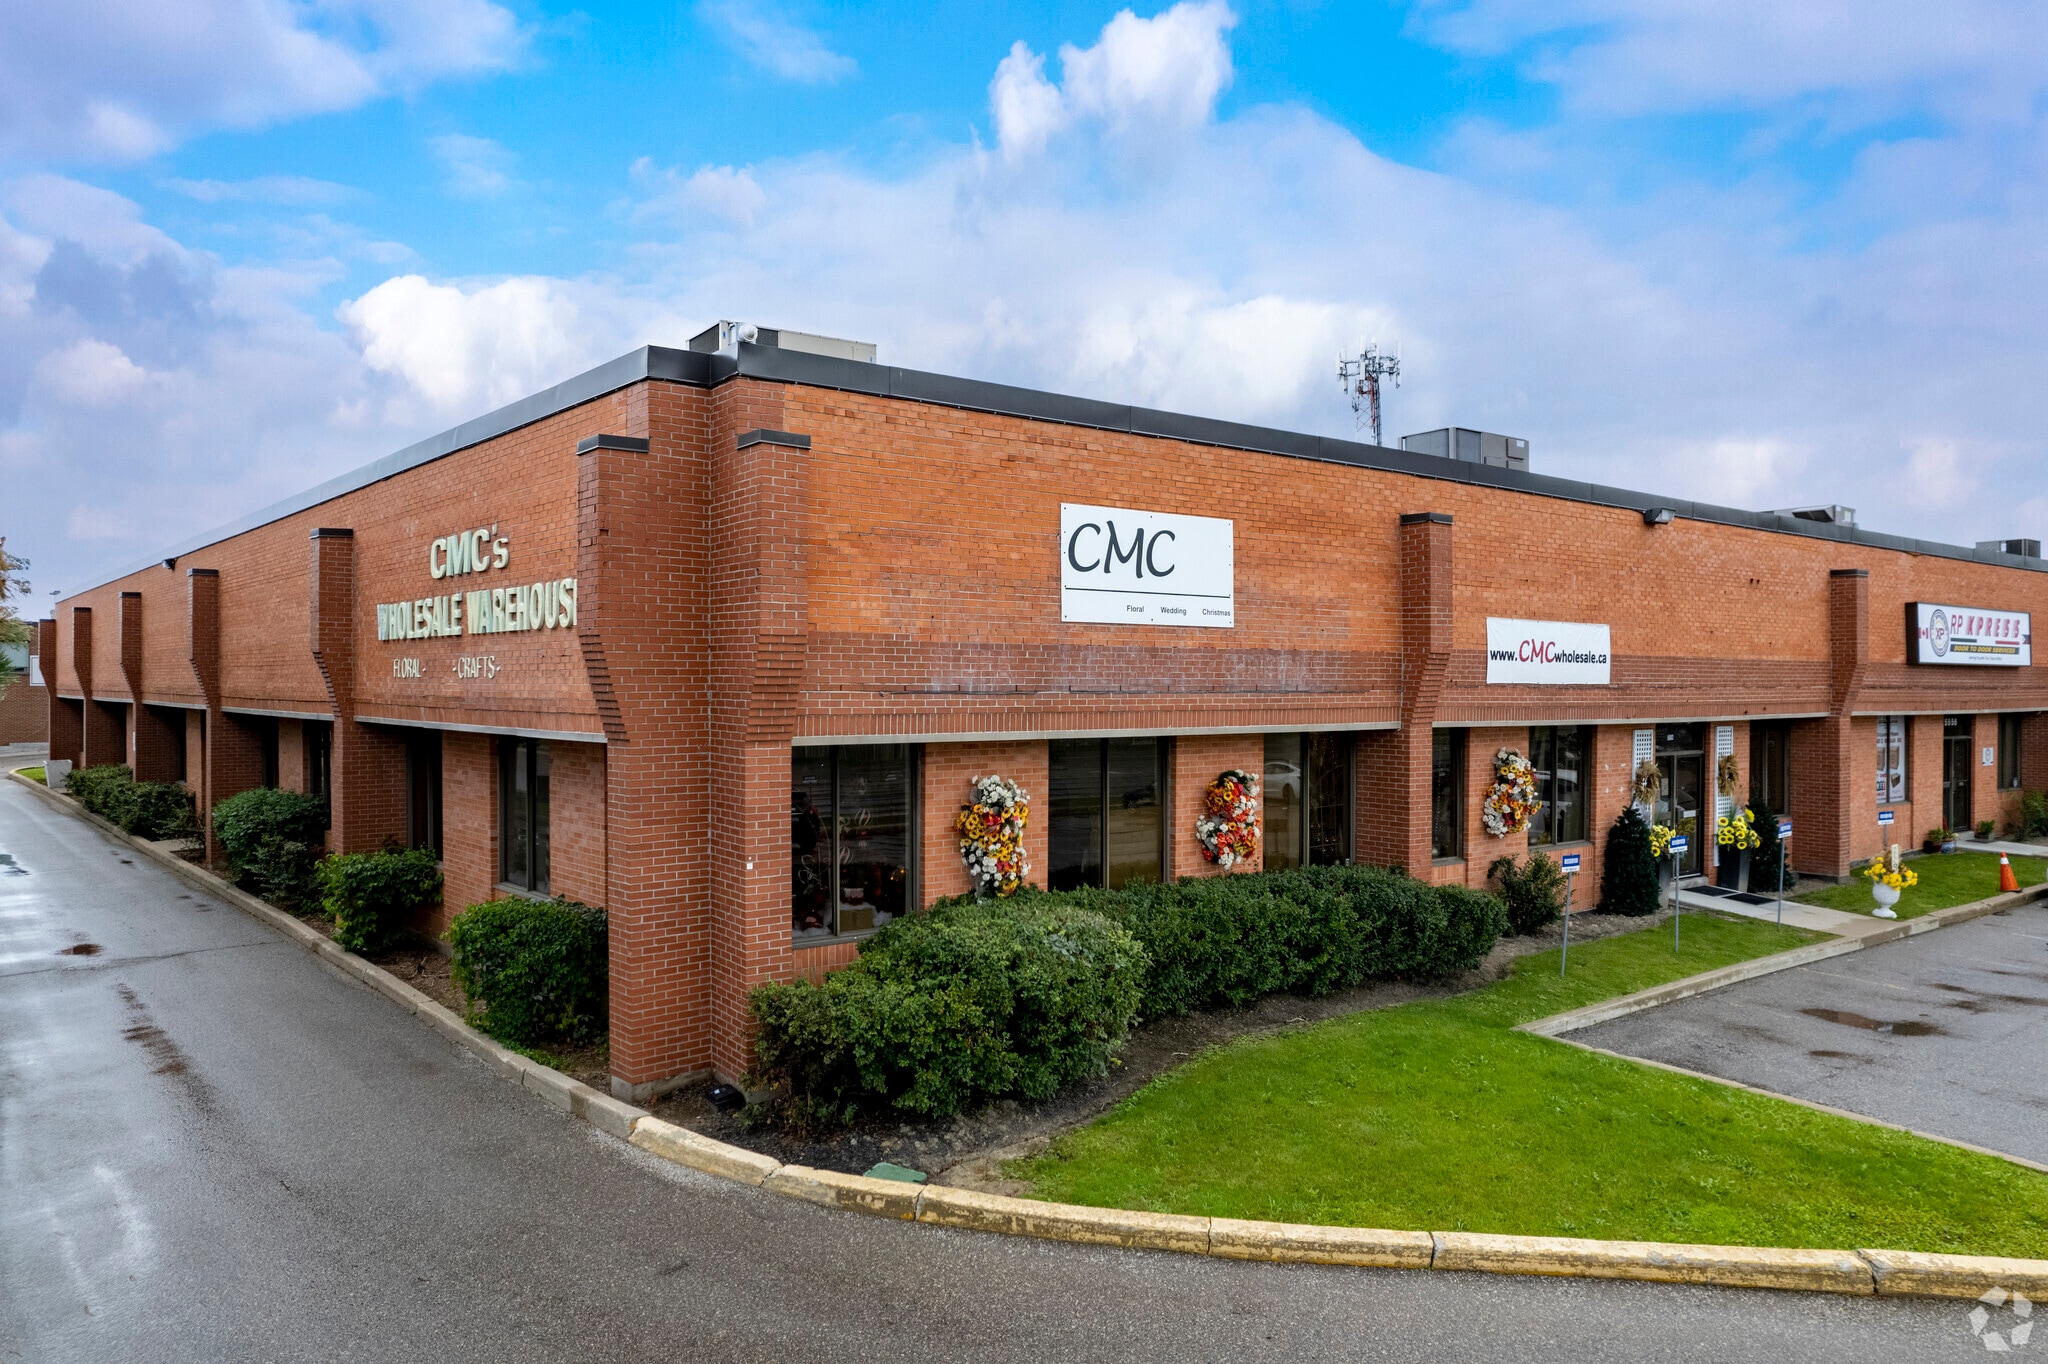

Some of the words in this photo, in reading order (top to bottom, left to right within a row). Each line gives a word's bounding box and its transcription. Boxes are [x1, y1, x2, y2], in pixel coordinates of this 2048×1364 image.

[430, 521, 509, 579] CMC's
[1068, 520, 1176, 579] CMC
[377, 592, 463, 641] WHOLESALE
[1126, 604, 1145, 613] Floral
[1160, 606, 1187, 616] Wedding
[1202, 608, 1231, 617] Christmas
[1950, 614, 1963, 635] RP
[1490, 638, 1607, 664] www.CMCwholesale.ca
[393, 657, 421, 679] FLORAL
[457, 655, 495, 679] CRAFTS
